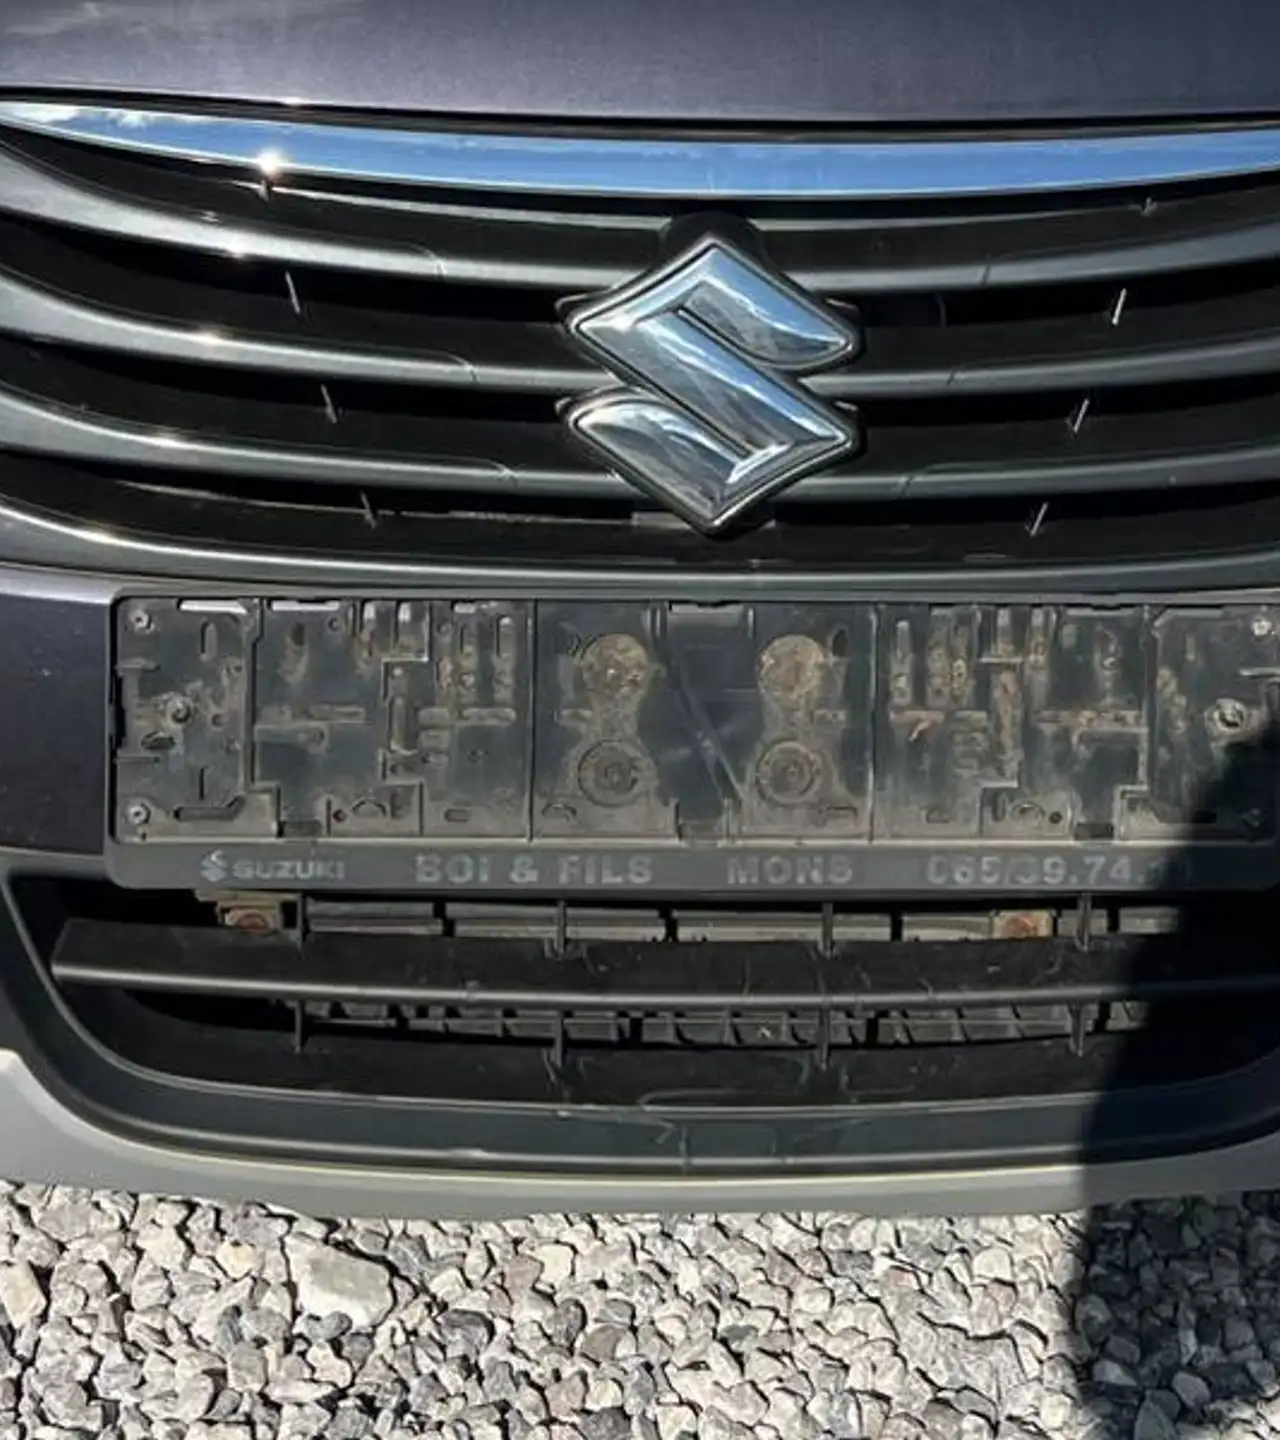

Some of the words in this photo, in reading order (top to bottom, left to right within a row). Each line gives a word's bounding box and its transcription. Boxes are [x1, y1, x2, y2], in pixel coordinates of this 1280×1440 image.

[508, 855, 539, 884] &
[558, 854, 653, 884] FILS
[726, 854, 854, 885] MONS
